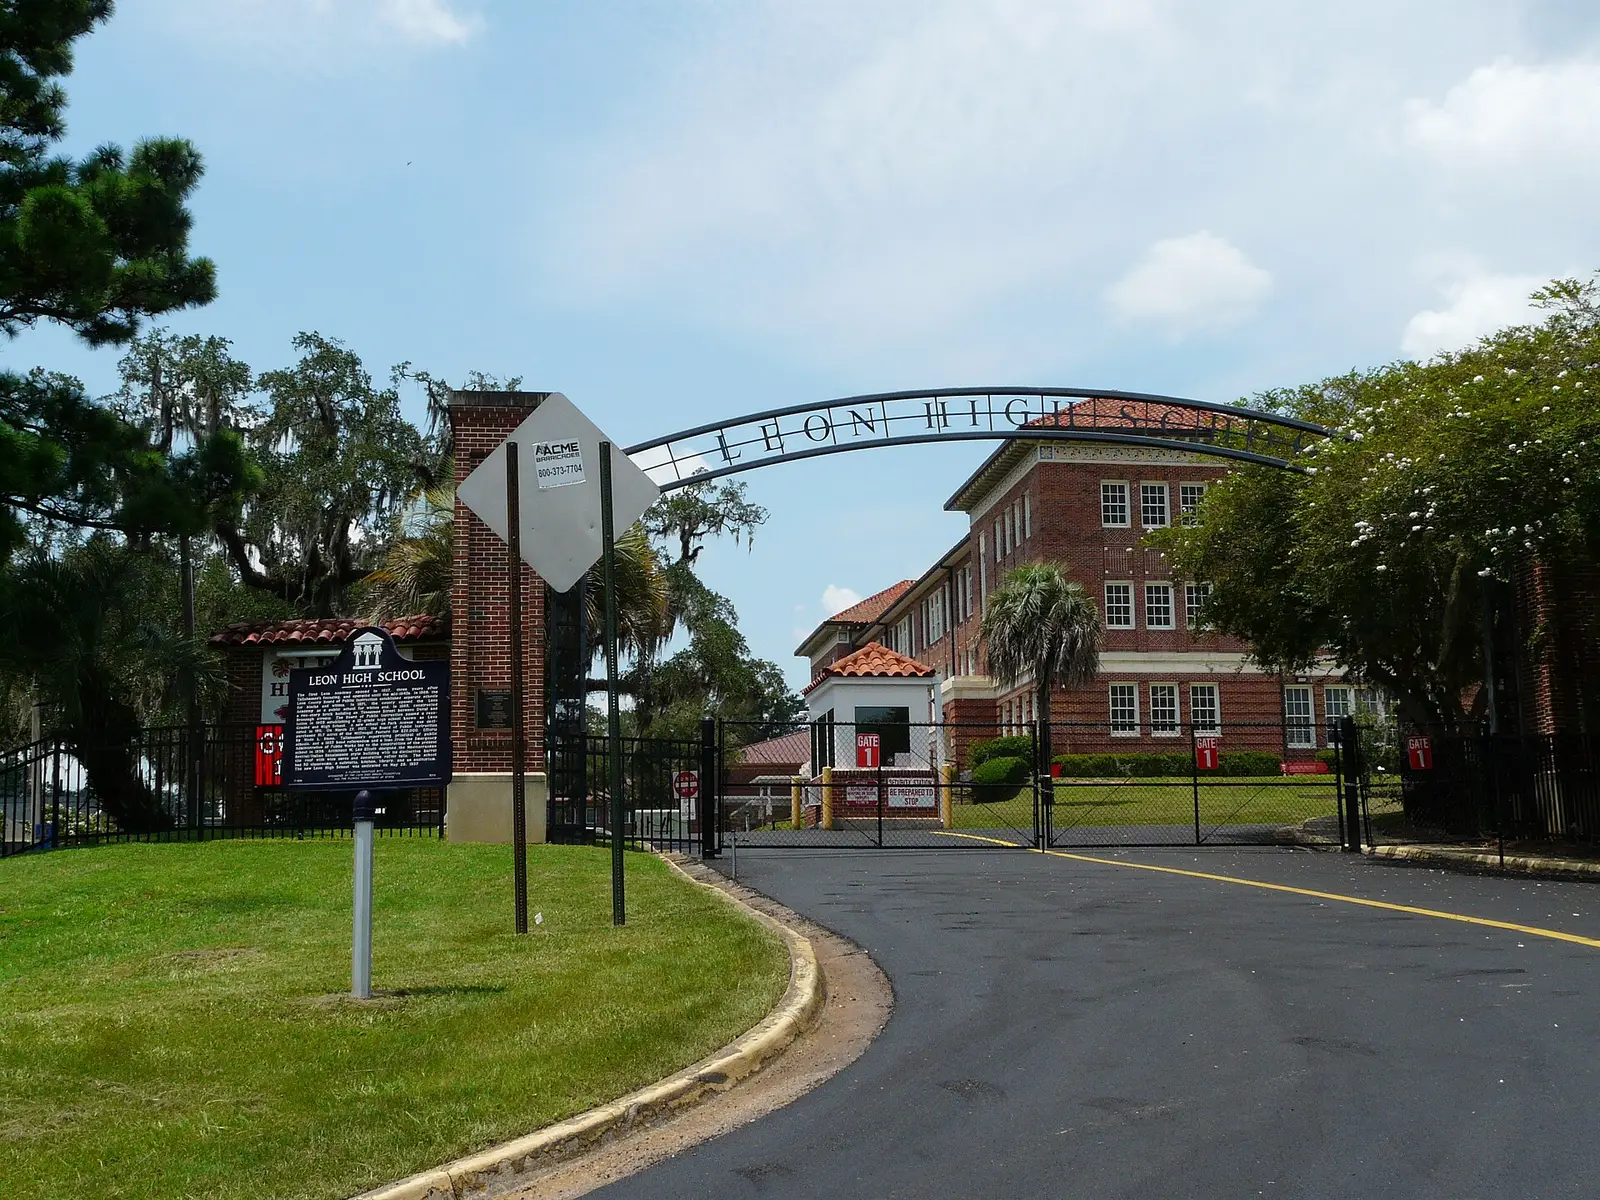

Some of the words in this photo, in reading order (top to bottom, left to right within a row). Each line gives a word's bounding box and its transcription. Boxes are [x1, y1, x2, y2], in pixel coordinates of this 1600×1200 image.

[713, 407, 876, 463] LEON
[922, 398, 1075, 430] HIGH
[536, 452, 580, 463] BARRICADES
[538, 464, 582, 478] 800-373-7704
[309, 674, 338, 686] LEON
[342, 672, 372, 684] HIGH
[378, 670, 426, 682] SCHOOL
[857, 736, 878, 748] GATE
[1196, 738, 1216, 749] GATE
[1408, 738, 1429, 749] GATE
[864, 748, 872, 766] 1
[1204, 750, 1212, 768] 1
[1416, 750, 1425, 768] 1
[904, 798, 918, 806] STOP
